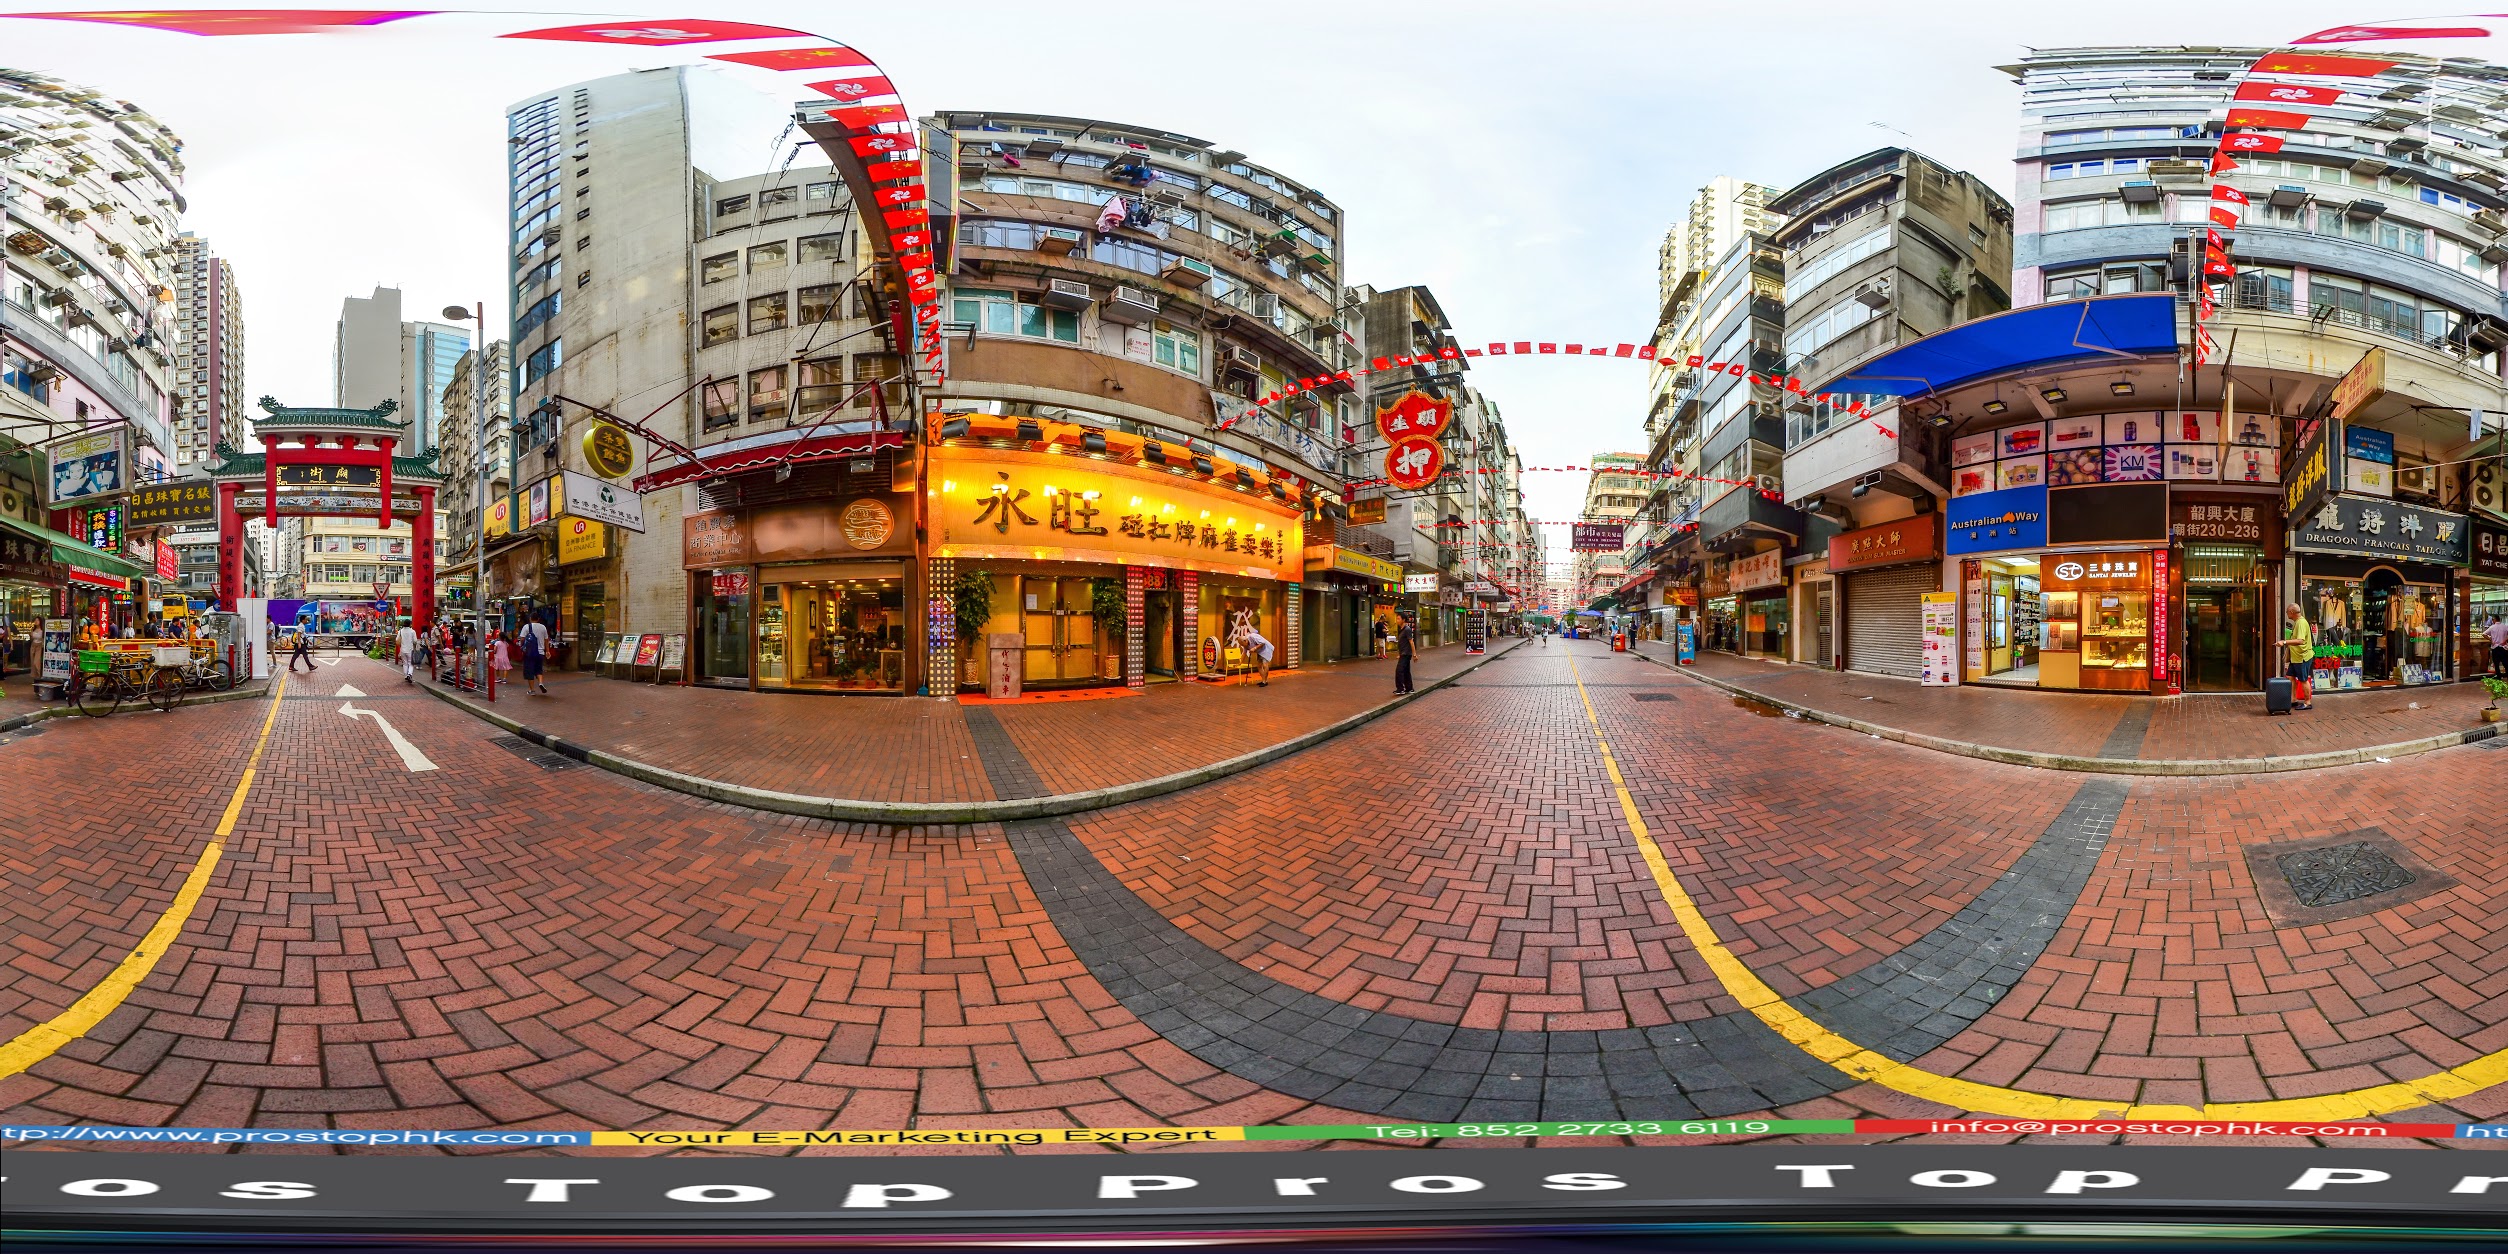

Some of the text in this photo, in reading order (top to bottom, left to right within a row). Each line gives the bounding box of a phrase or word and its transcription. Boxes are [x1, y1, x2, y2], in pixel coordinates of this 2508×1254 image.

[2355, 434, 2387, 446] Australian
[2368, 443, 2381, 451] Way
[1395, 445, 1433, 477] 押
[2120, 455, 2144, 467] KM
[132, 486, 212, 506] 日昌珠寶名錶
[973, 471, 1109, 536] 永旺
[1951, 512, 2039, 530] Australian Way
[2190, 505, 2255, 523] 韶興大廈
[2314, 502, 2459, 545] 龍將洋服
[689, 531, 743, 550] 商業中心
[1970, 527, 2017, 540] 澳洲站
[573, 541, 597, 553] FINANCE
[1886, 548, 1906, 556] MASTER
[2305, 533, 2463, 558] DRAGOON FRANCAIS TAILOR CO
[2481, 532, 2508, 557] 日昌
[2482, 559, 2493, 567] YAT
